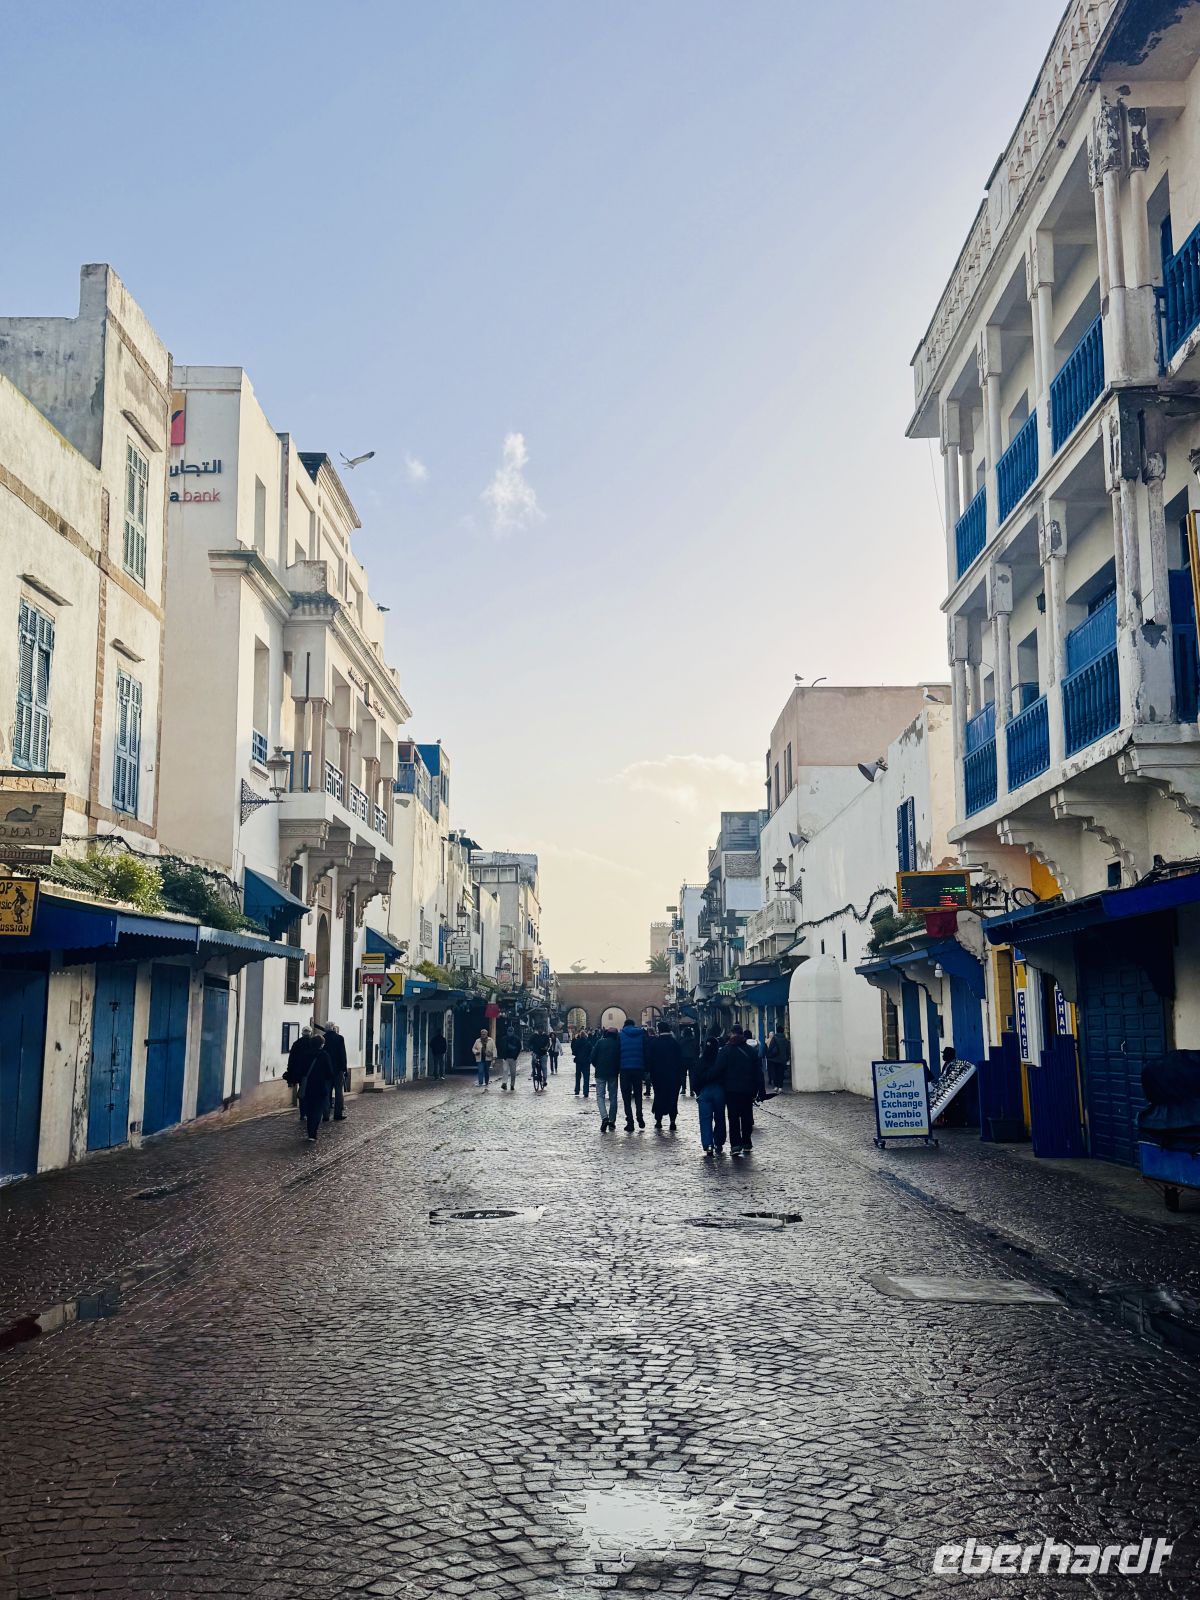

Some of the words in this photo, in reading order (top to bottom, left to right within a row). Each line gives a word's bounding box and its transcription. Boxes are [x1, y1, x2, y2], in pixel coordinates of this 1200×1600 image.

[183, 488, 221, 502] bank
[1019, 994, 1028, 1058] CHANGE
[886, 1080, 915, 1090] الصرف
[883, 1091, 920, 1100] Change
[881, 1100, 923, 1109] Exchange
[885, 1110, 921, 1118] Cambio
[885, 1120, 923, 1128] Wechsel
